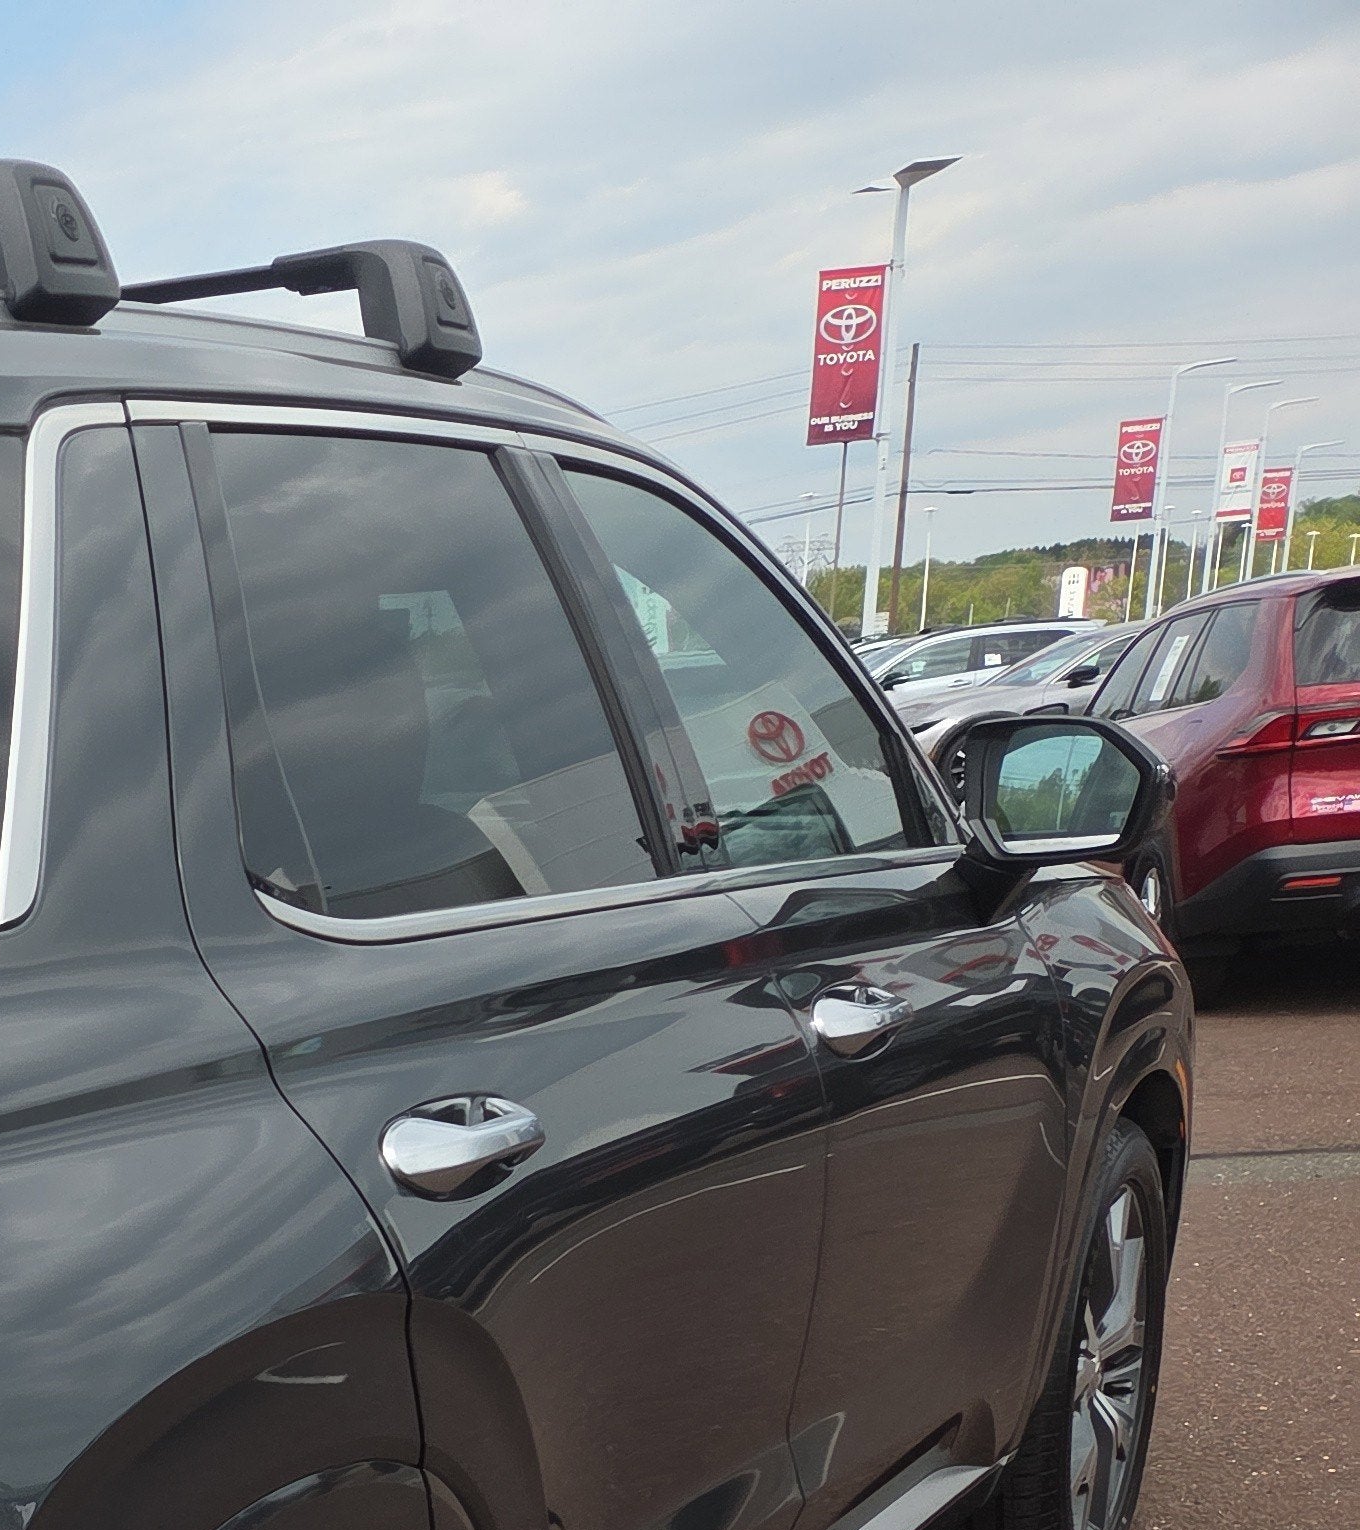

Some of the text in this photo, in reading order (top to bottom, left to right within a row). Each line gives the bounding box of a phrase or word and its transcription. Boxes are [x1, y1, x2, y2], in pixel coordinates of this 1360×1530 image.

[822, 275, 882, 291] PERUZZI
[818, 349, 876, 366] TOYOTA
[836, 420, 859, 431] YOU
[1119, 465, 1155, 476] TOYOTA
